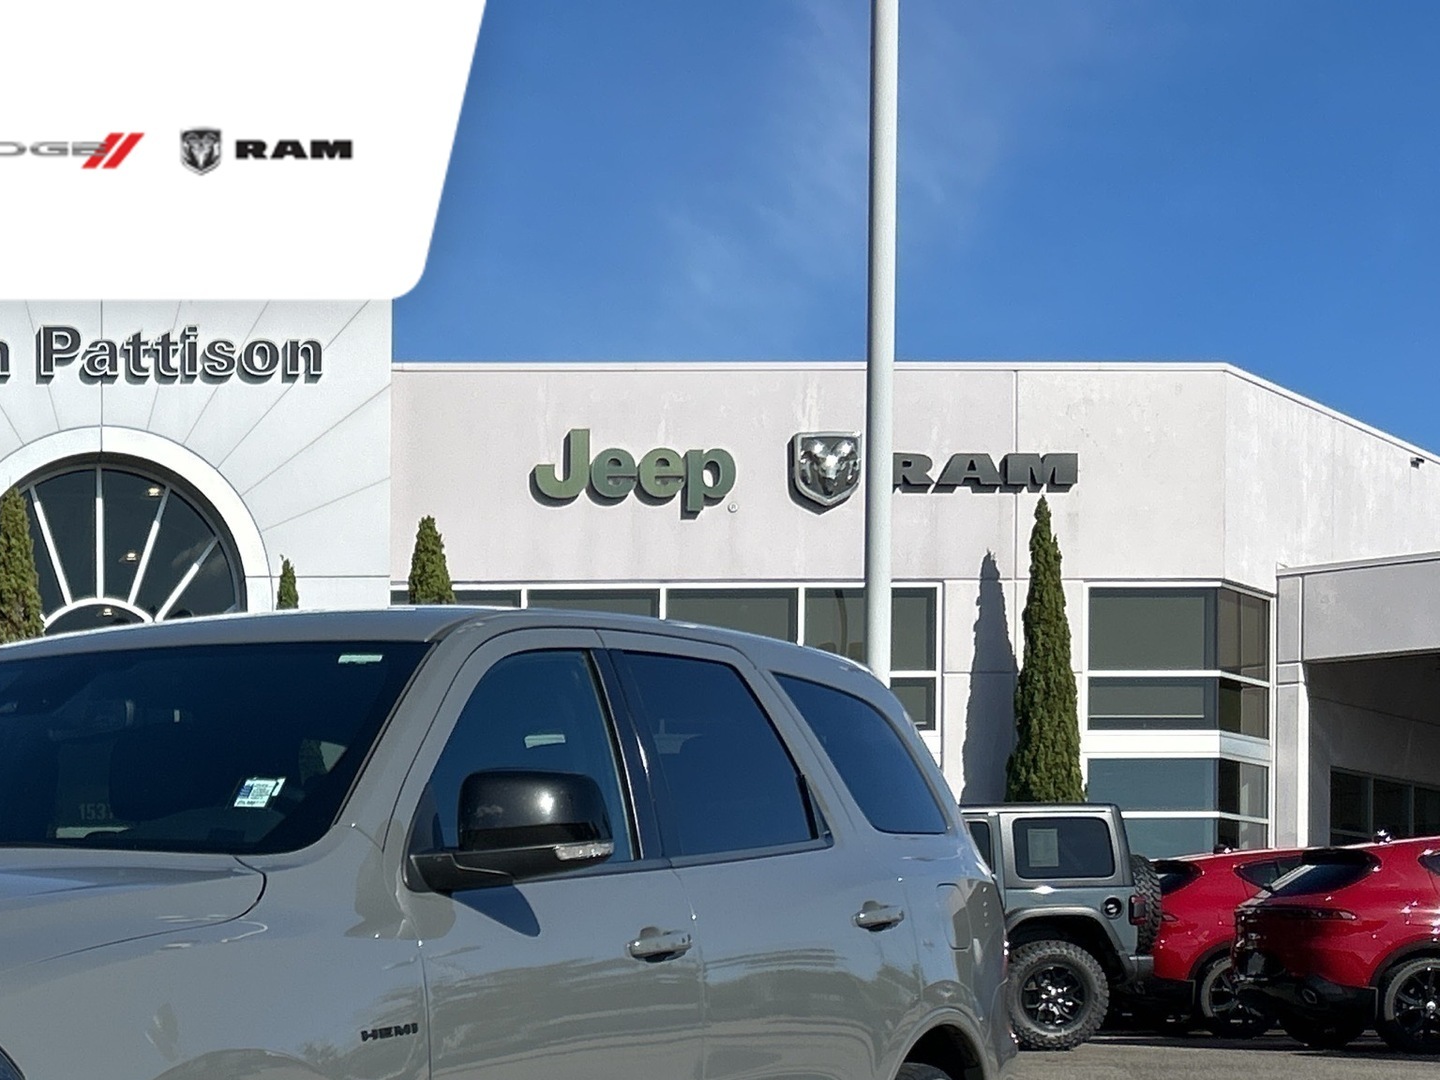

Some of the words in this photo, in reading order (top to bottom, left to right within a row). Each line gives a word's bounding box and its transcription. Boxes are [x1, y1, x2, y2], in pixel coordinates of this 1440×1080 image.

[35, 325, 325, 384] Pattison
[530, 428, 737, 519] Jeep
[892, 452, 1078, 494] RAM
[360, 1022, 419, 1042] HEMI
